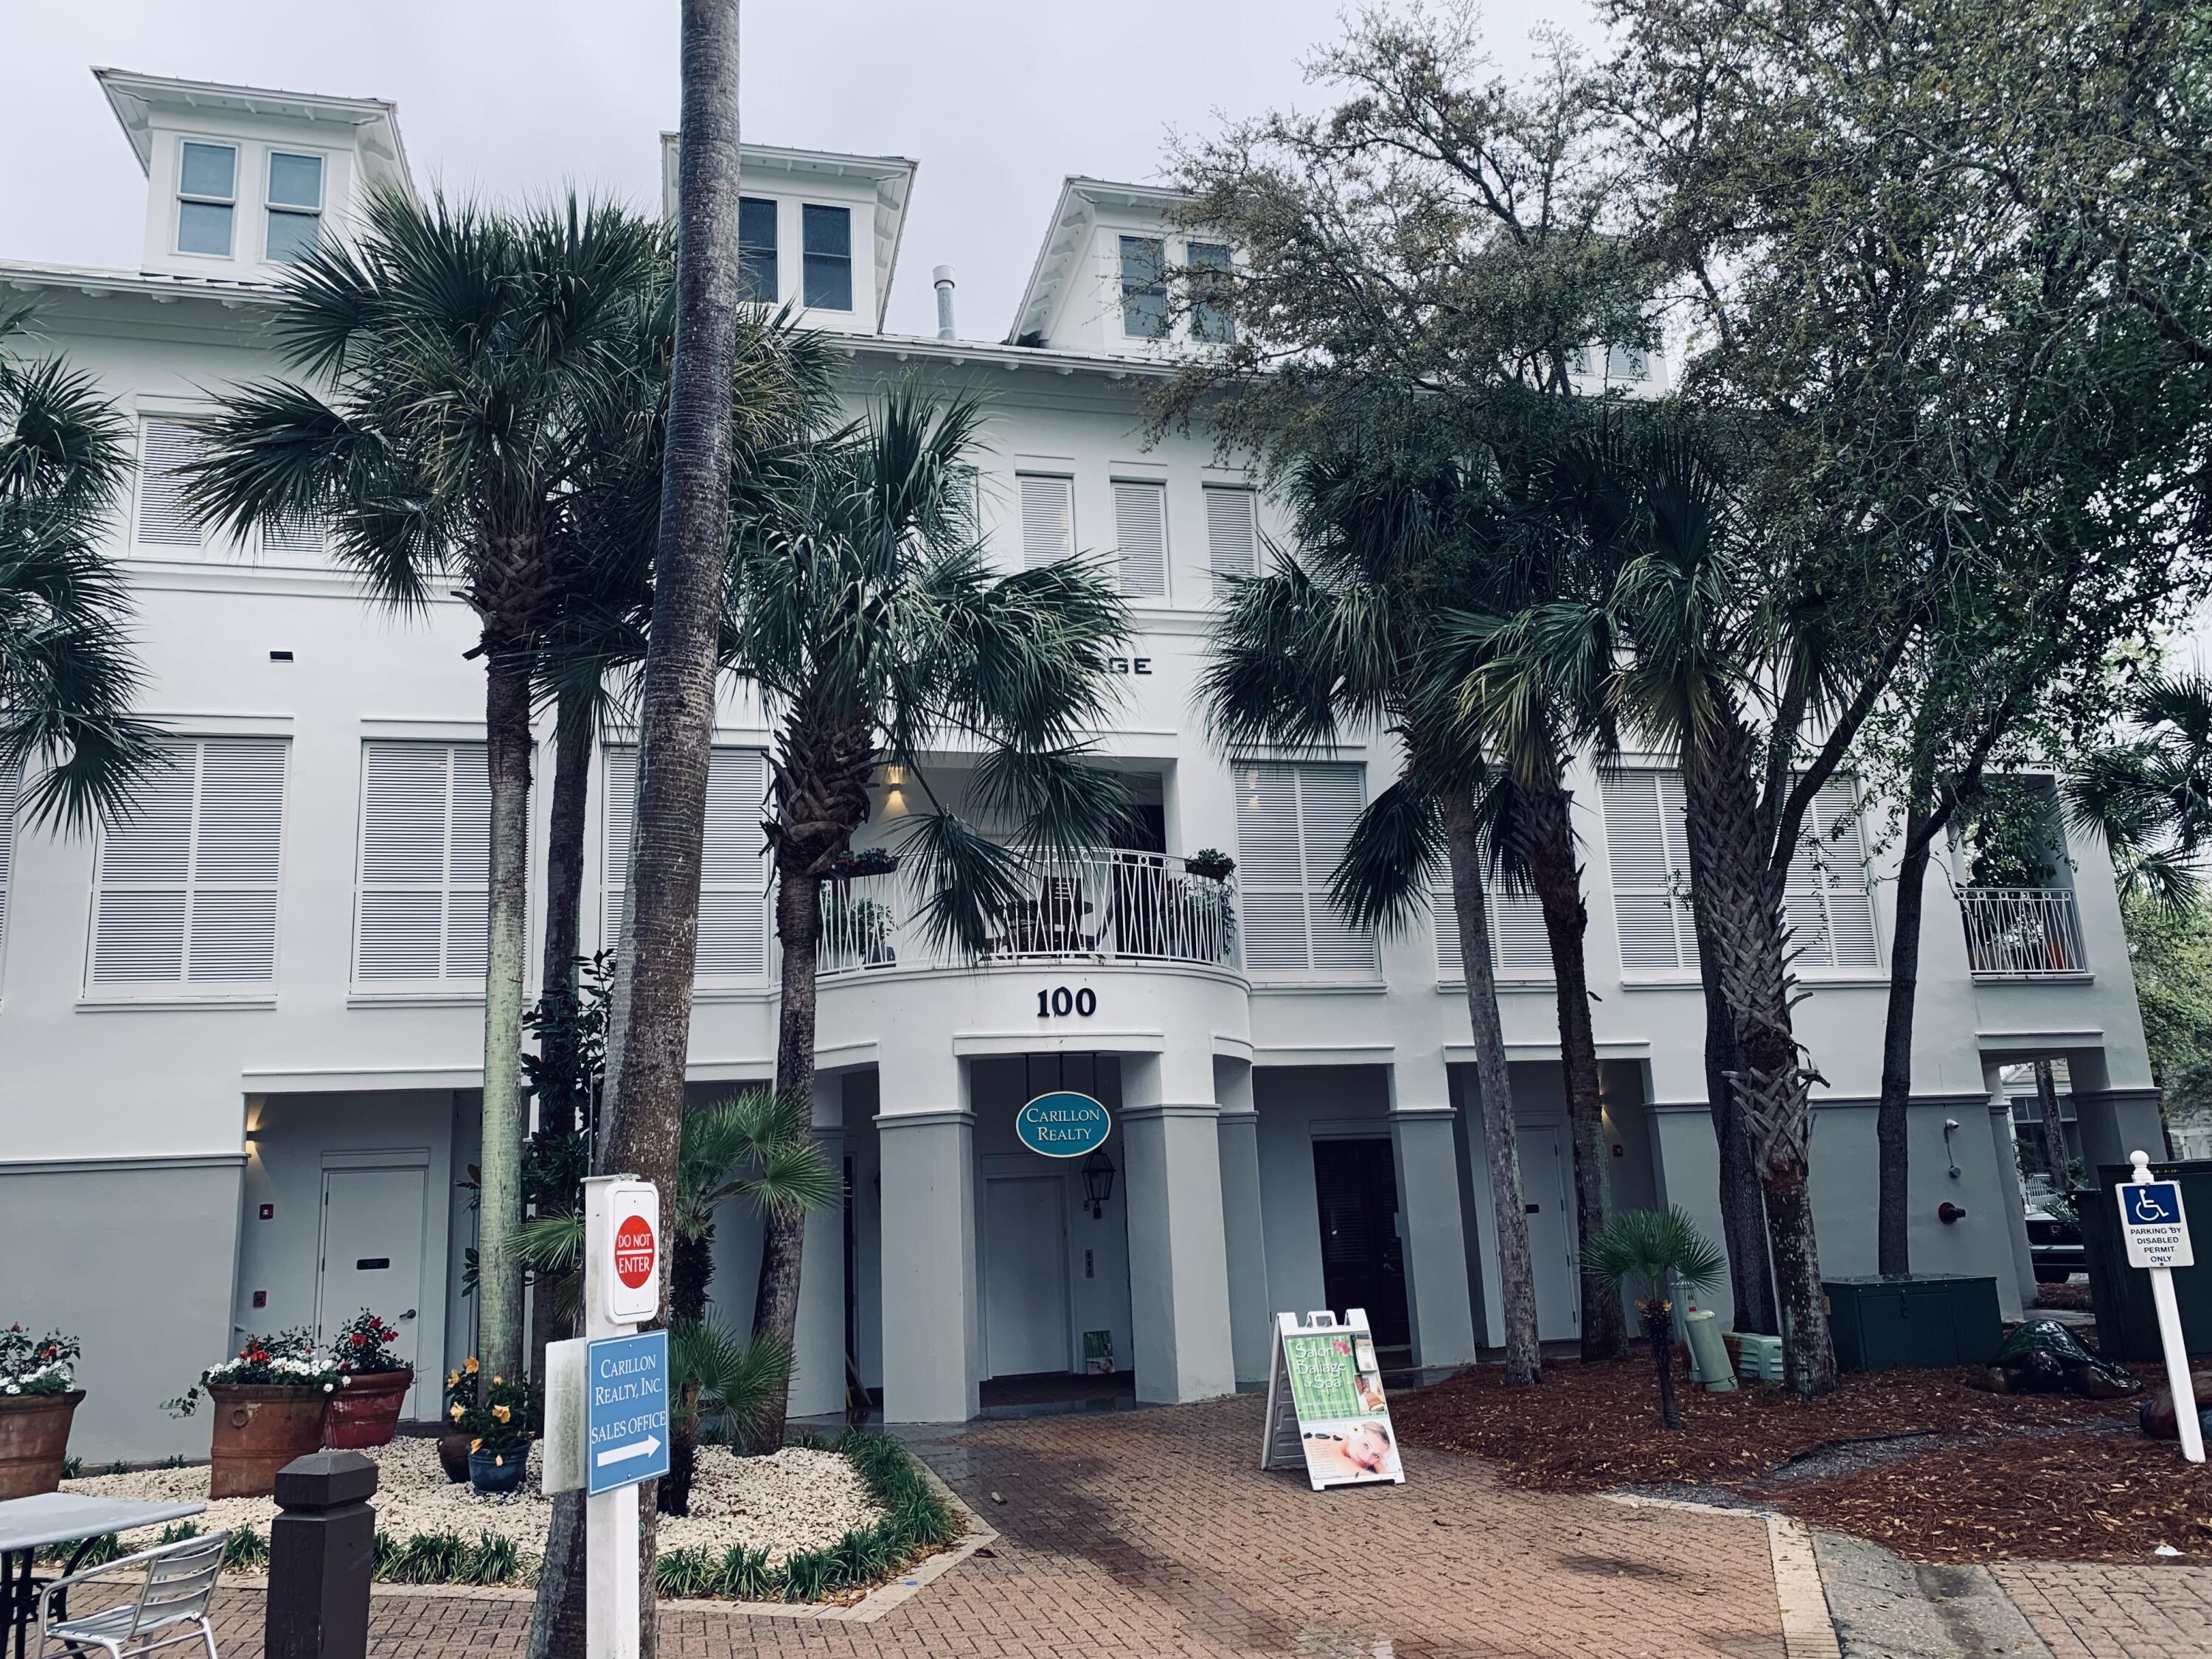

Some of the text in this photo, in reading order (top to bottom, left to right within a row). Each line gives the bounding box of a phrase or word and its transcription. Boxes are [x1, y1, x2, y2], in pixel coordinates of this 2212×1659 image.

[1109, 658, 1152, 674] GE
[1037, 987, 1097, 1019] 100
[1026, 1108, 1100, 1123] CARILLON
[1037, 1127, 1092, 1141] REALTY
[618, 1234, 651, 1248] DO NOT
[2137, 1237, 2179, 1245] DISABLED
[619, 1256, 650, 1273] ENTER
[1295, 1341, 1334, 1358] Salon
[601, 1354, 656, 1378] CARILLON
[1298, 1357, 1346, 1378] Baliage
[595, 1377, 663, 1406] REALTY, INC.
[1304, 1375, 1341, 1395] & Spa
[591, 1411, 667, 1444] SALES OFFICE
